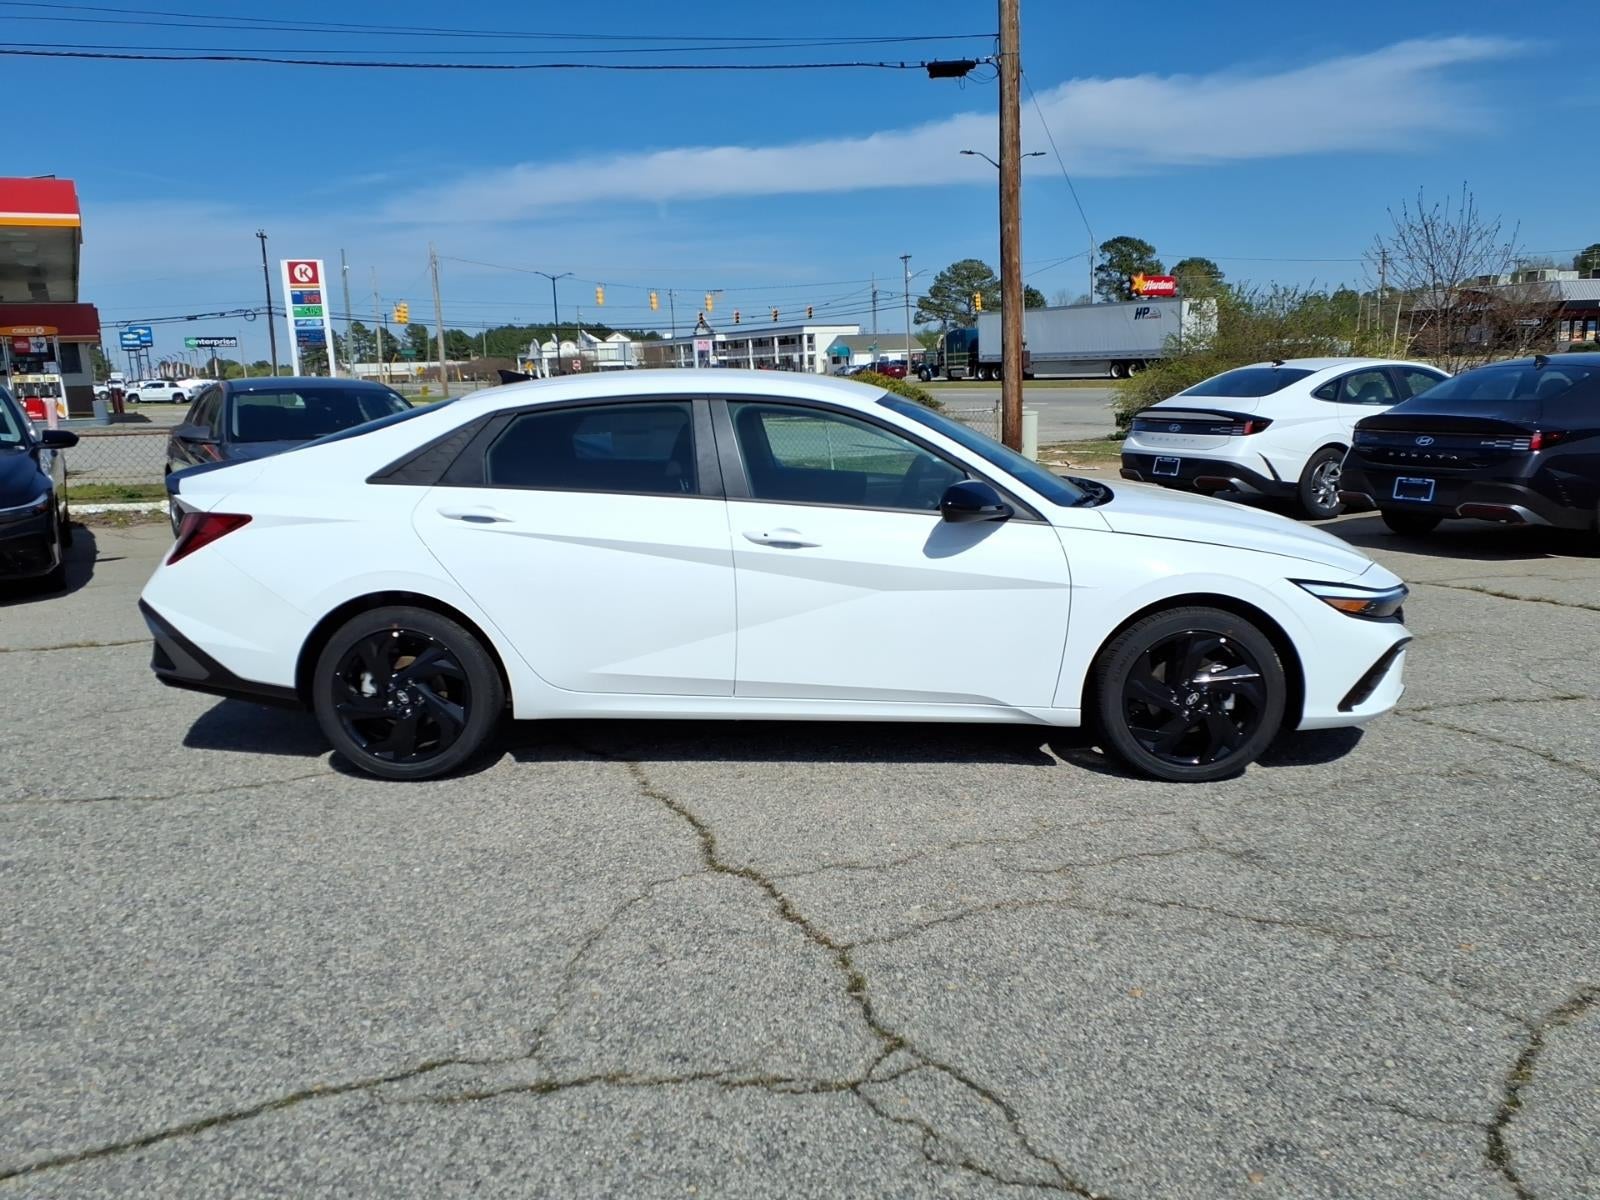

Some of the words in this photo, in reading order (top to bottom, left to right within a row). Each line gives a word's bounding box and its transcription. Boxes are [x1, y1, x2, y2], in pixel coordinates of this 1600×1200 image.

[298, 266, 312, 281] K
[1142, 279, 1174, 291] Hardee's
[1134, 306, 1150, 321] HP
[188, 338, 237, 346] enterprise
[1388, 451, 1459, 460] SONATA
